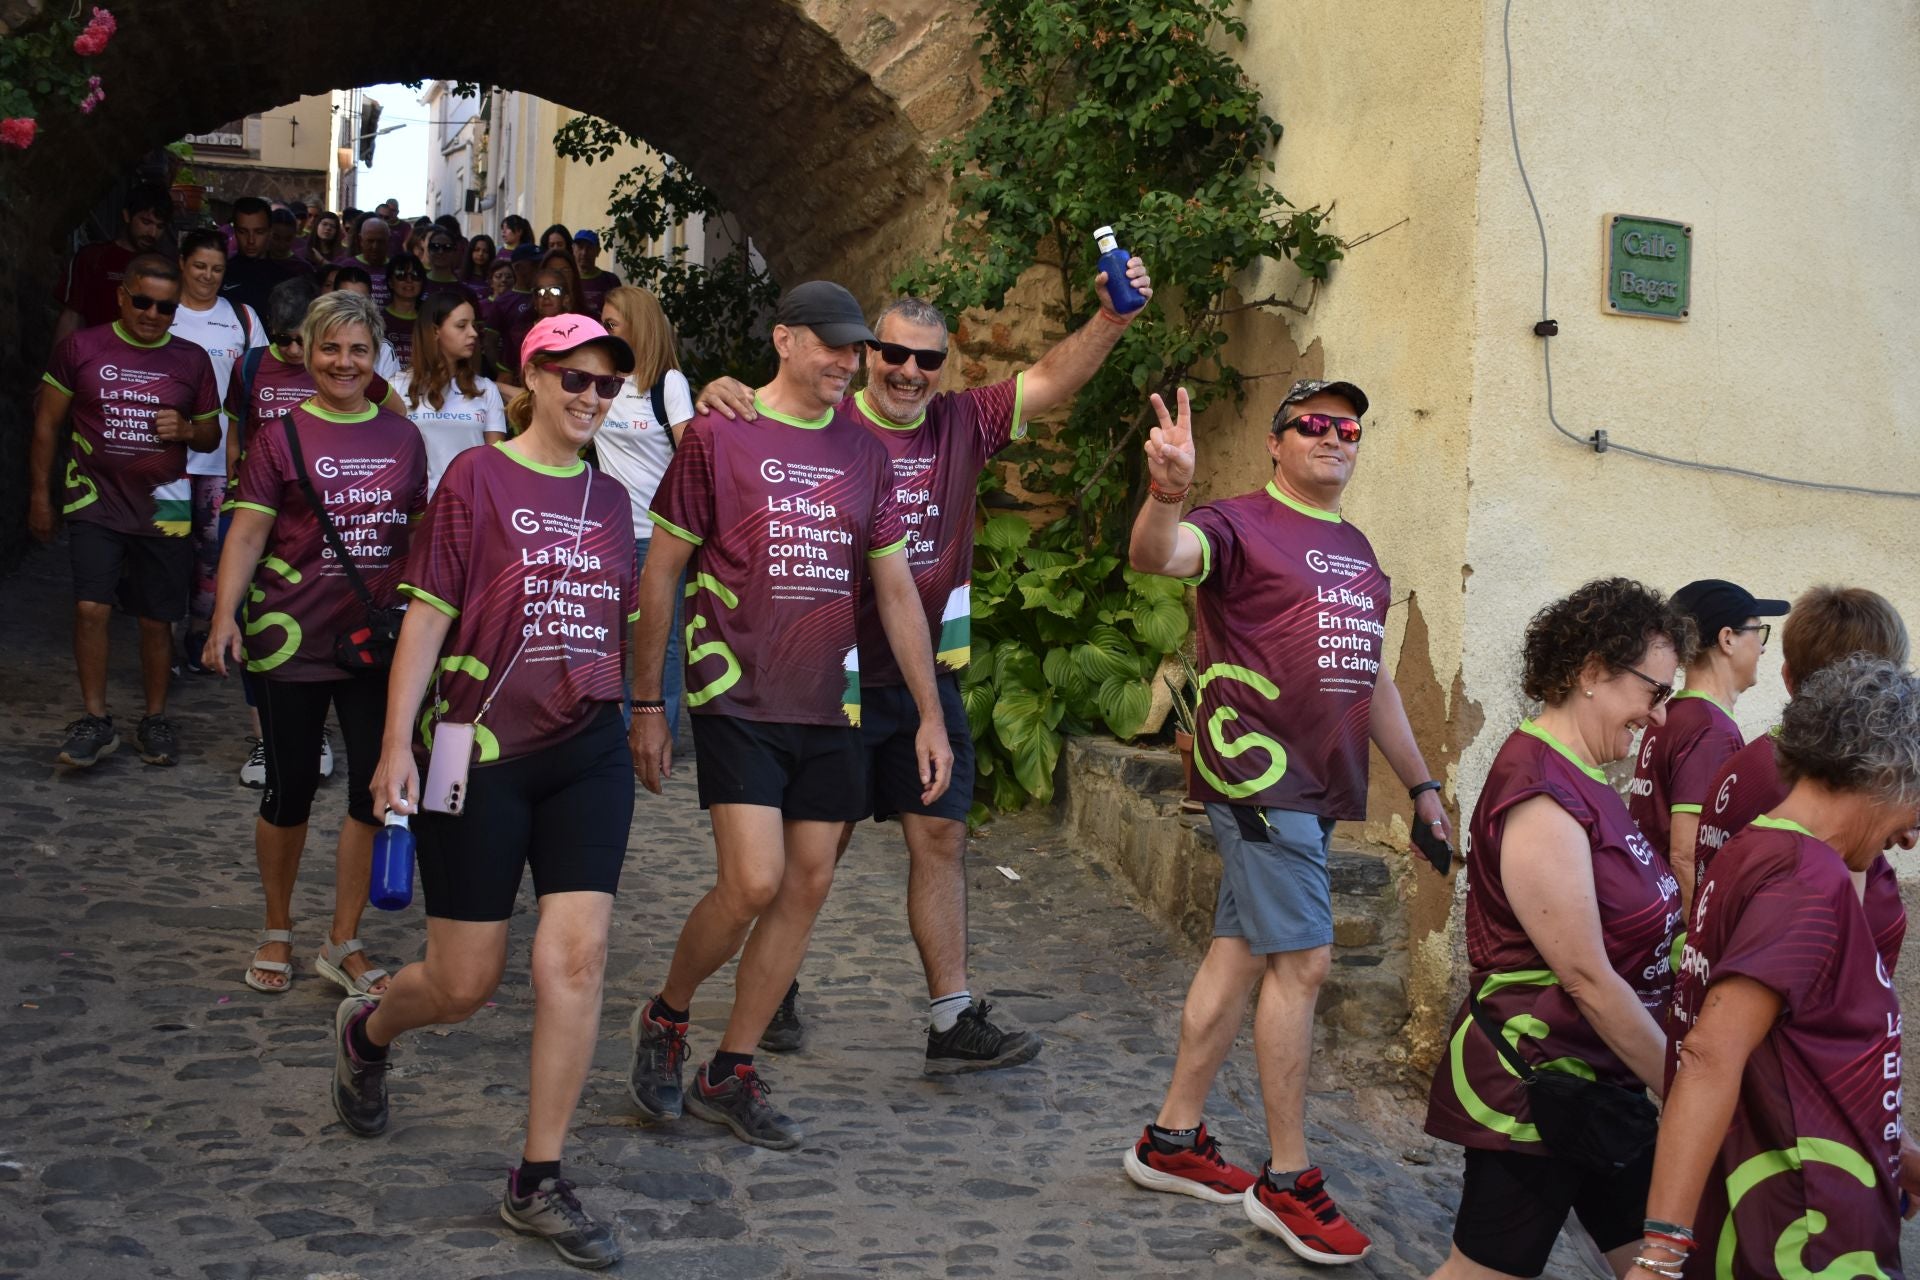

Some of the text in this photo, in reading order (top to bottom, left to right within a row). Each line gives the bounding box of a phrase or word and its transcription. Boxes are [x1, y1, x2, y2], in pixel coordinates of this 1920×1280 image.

[1622, 231, 1677, 258] Calle
[1620, 271, 1678, 303] Bagar
[101, 388, 160, 404] La Rioja
[103, 404, 158, 418] En marc
[259, 407, 274, 418] La
[423, 411, 472, 421] mueves
[105, 417, 149, 430] contra
[603, 419, 629, 430] ueves
[103, 428, 161, 444] el cánce
[787, 463, 845, 476] asociación española
[788, 469, 807, 477] contra
[805, 478, 820, 488] Rioja
[324, 487, 392, 505] La Rioja
[896, 488, 930, 505] Rioja
[350, 508, 408, 525] marcha
[768, 495, 836, 521] La Rioja
[769, 520, 853, 545] En marcha
[522, 546, 601, 573] La Rioja
[768, 542, 828, 560] contra
[768, 560, 850, 582] el cáncer
[524, 576, 620, 601] En marcha
[1317, 585, 1374, 611] La Rioja
[523, 597, 585, 618] contra
[522, 617, 609, 642] el cáncer
[1318, 612, 1384, 639] En marcha
[1317, 633, 1371, 653] contra
[1317, 651, 1380, 676] el cáncer
